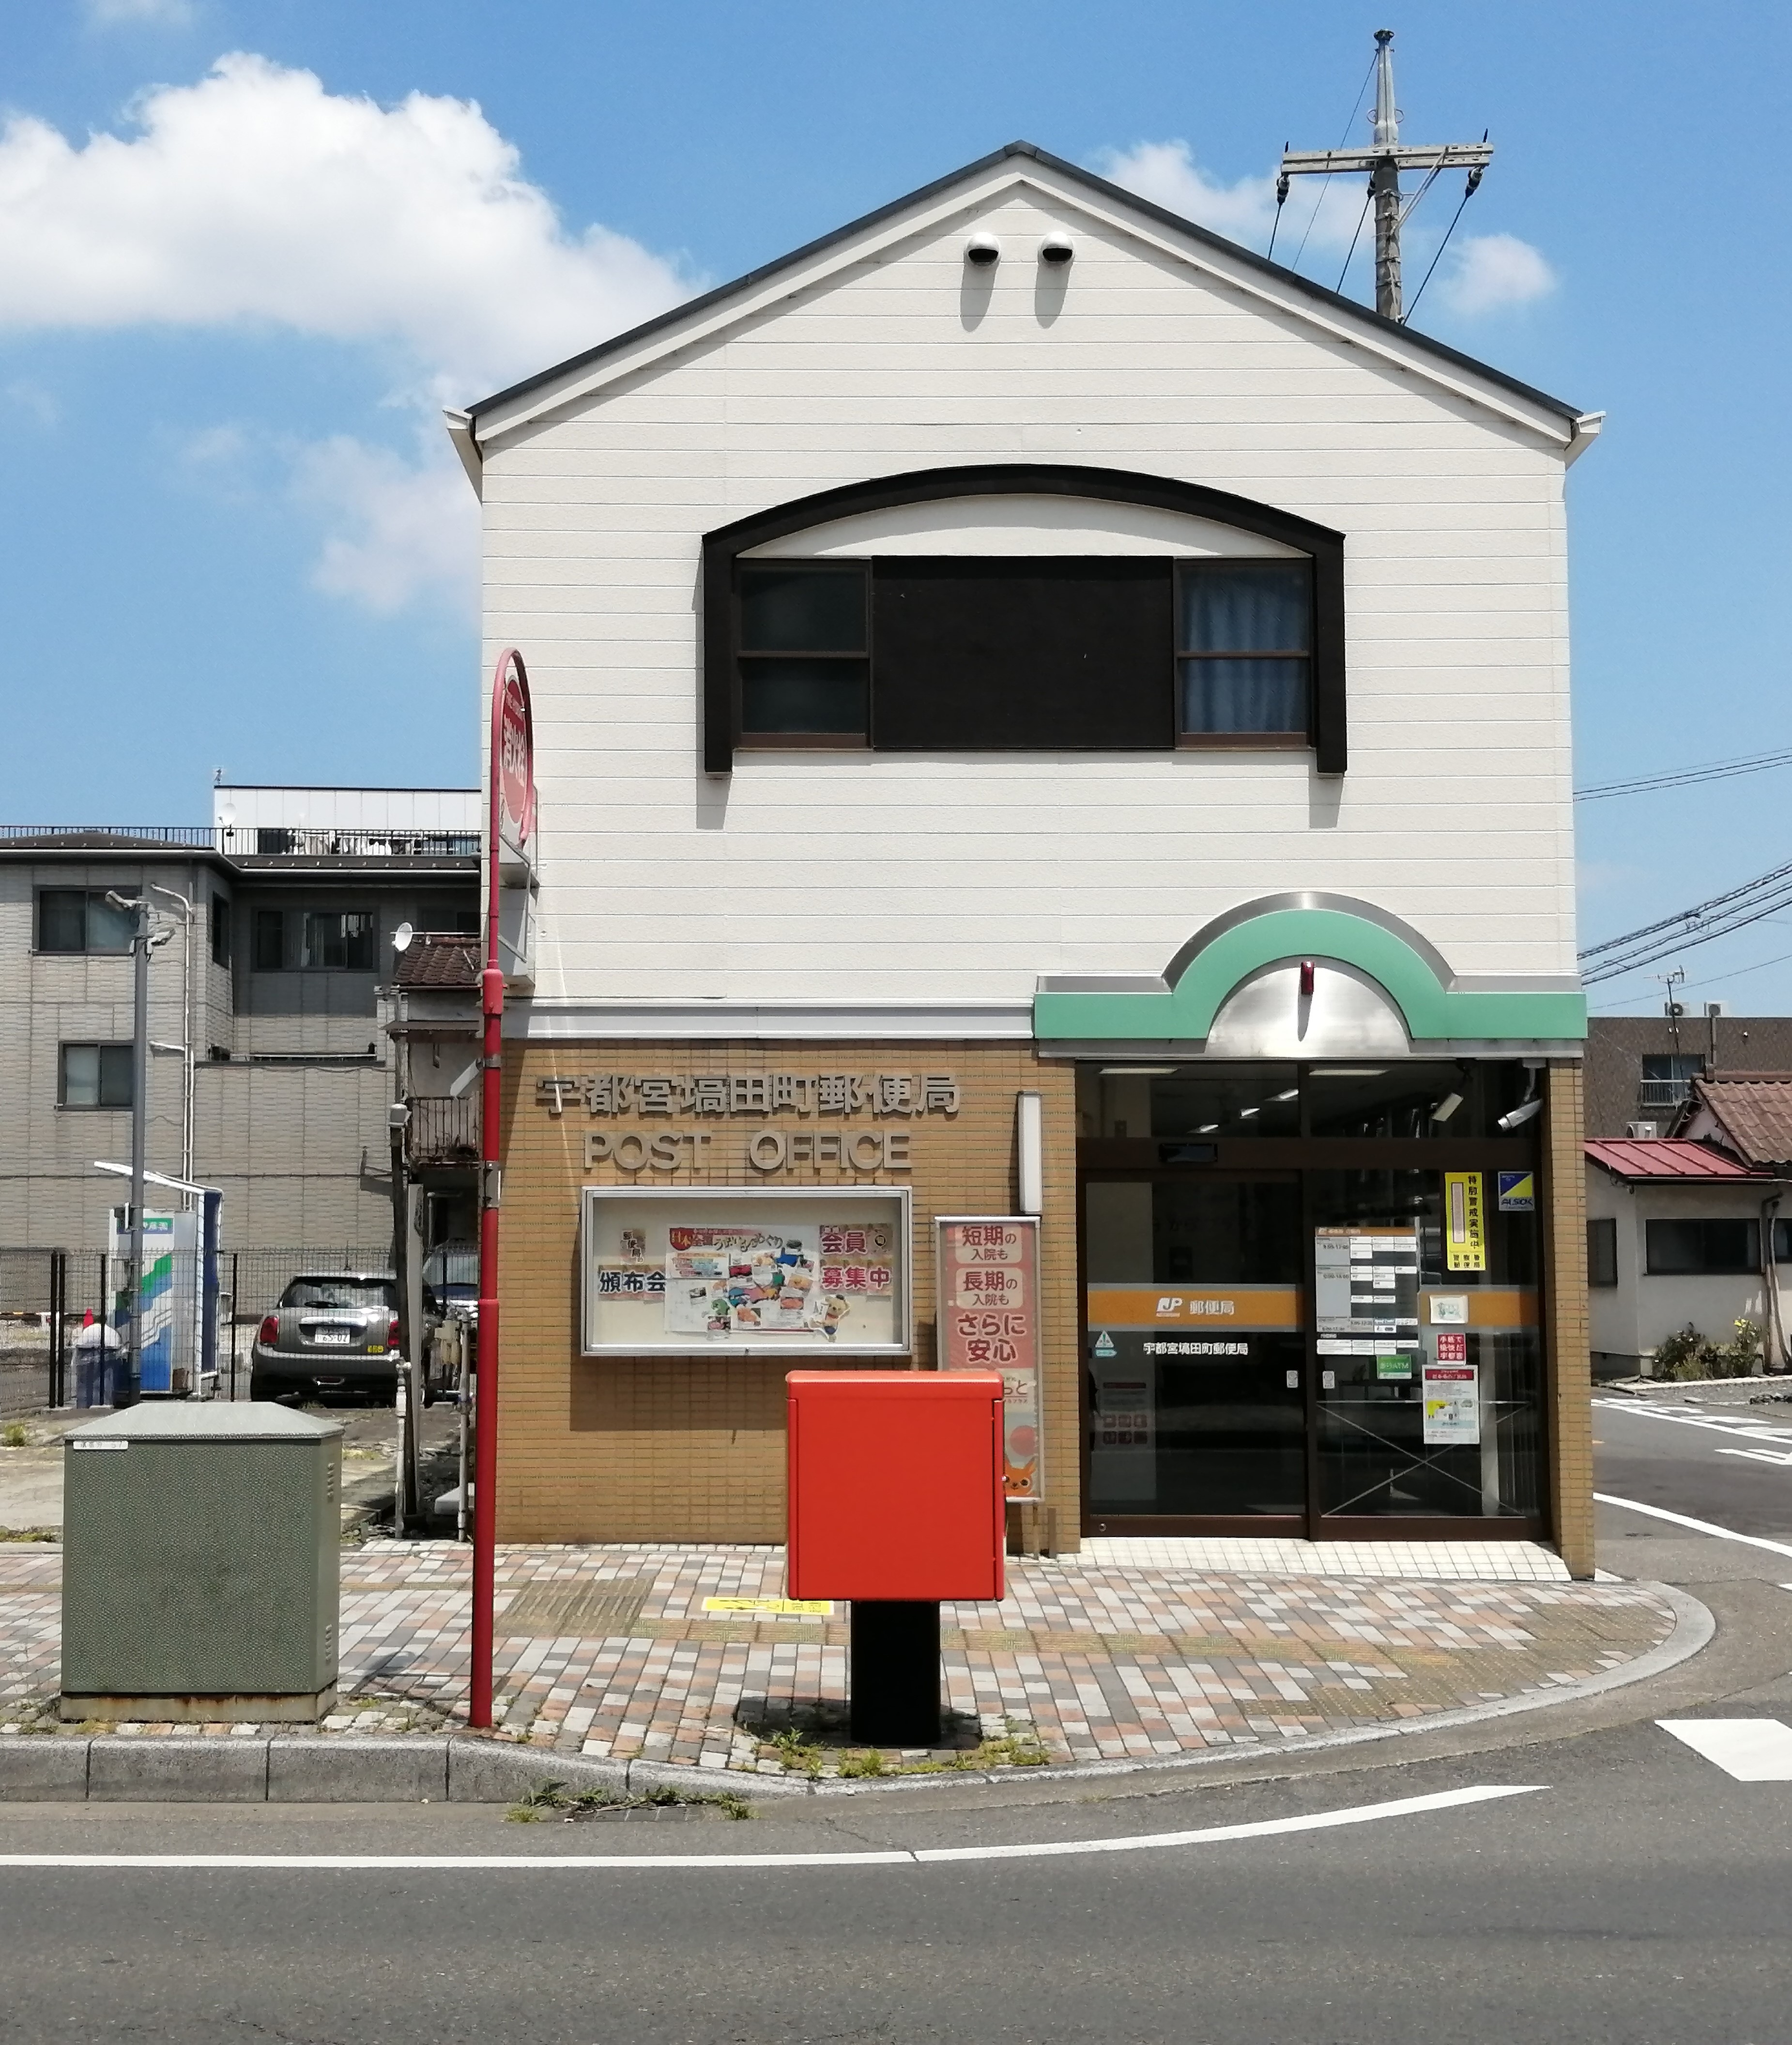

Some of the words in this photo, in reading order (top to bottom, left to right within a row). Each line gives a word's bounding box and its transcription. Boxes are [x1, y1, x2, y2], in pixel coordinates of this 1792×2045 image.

[536, 1073, 961, 1114] 宇都宮塙田町郵便局
[584, 1130, 711, 1170] POST
[749, 1130, 912, 1170] OFFICE
[1501, 1198, 1533, 1206] ALSOK
[821, 1231, 867, 1254] 会員
[962, 1225, 1016, 1247] 短期の
[971, 1248, 1008, 1261] 入院も
[599, 1270, 665, 1292] 頒布会
[821, 1266, 890, 1289] 募集中
[963, 1270, 1017, 1292] 長期の
[972, 1293, 1009, 1306] 入院も
[1190, 1300, 1235, 1315] 郵便局
[957, 1313, 1026, 1336] さらに
[967, 1338, 1016, 1362] 安心
